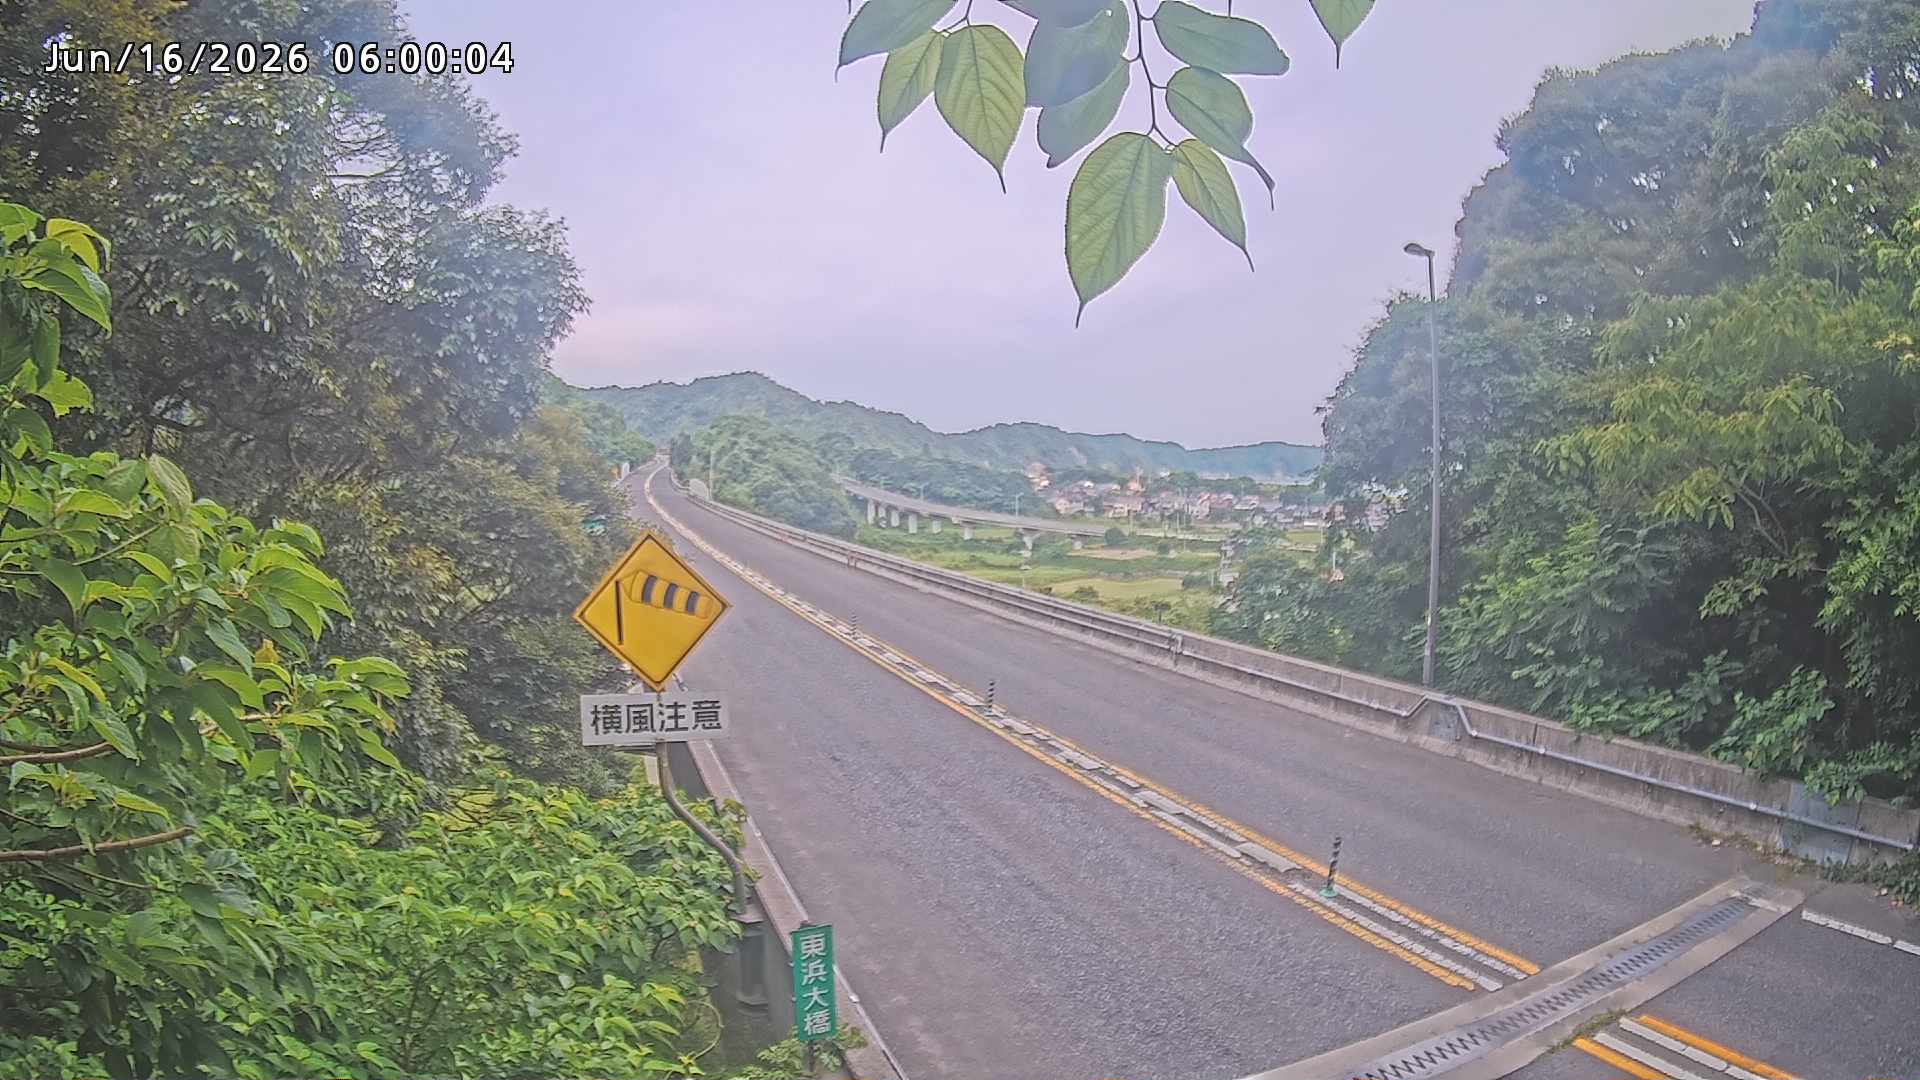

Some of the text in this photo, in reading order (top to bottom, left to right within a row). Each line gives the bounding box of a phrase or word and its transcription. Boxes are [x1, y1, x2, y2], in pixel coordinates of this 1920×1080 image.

[590, 700, 722, 735] 横風注意
[800, 933, 832, 1035] 東浜大橋
